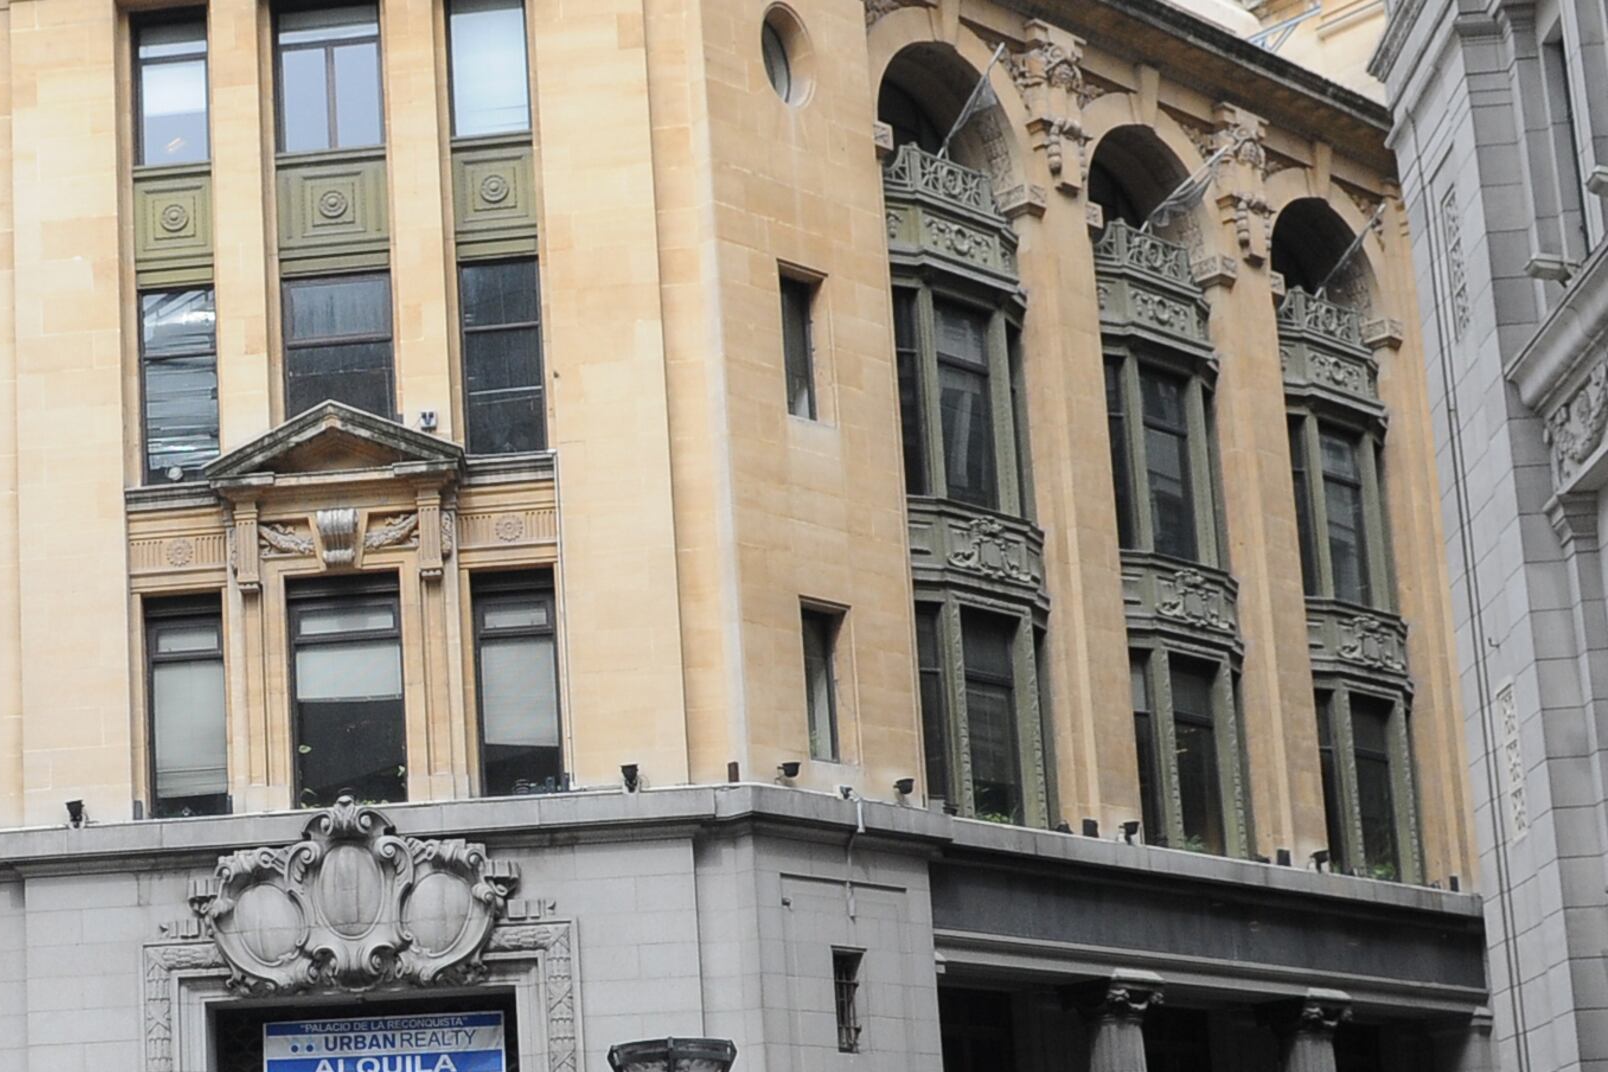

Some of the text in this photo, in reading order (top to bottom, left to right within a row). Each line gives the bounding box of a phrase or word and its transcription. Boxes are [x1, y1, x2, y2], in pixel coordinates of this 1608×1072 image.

[353, 1022, 368, 1031] DE
[371, 1020, 385, 1030] LA
[324, 1029, 477, 1052] URBAN REALTY
